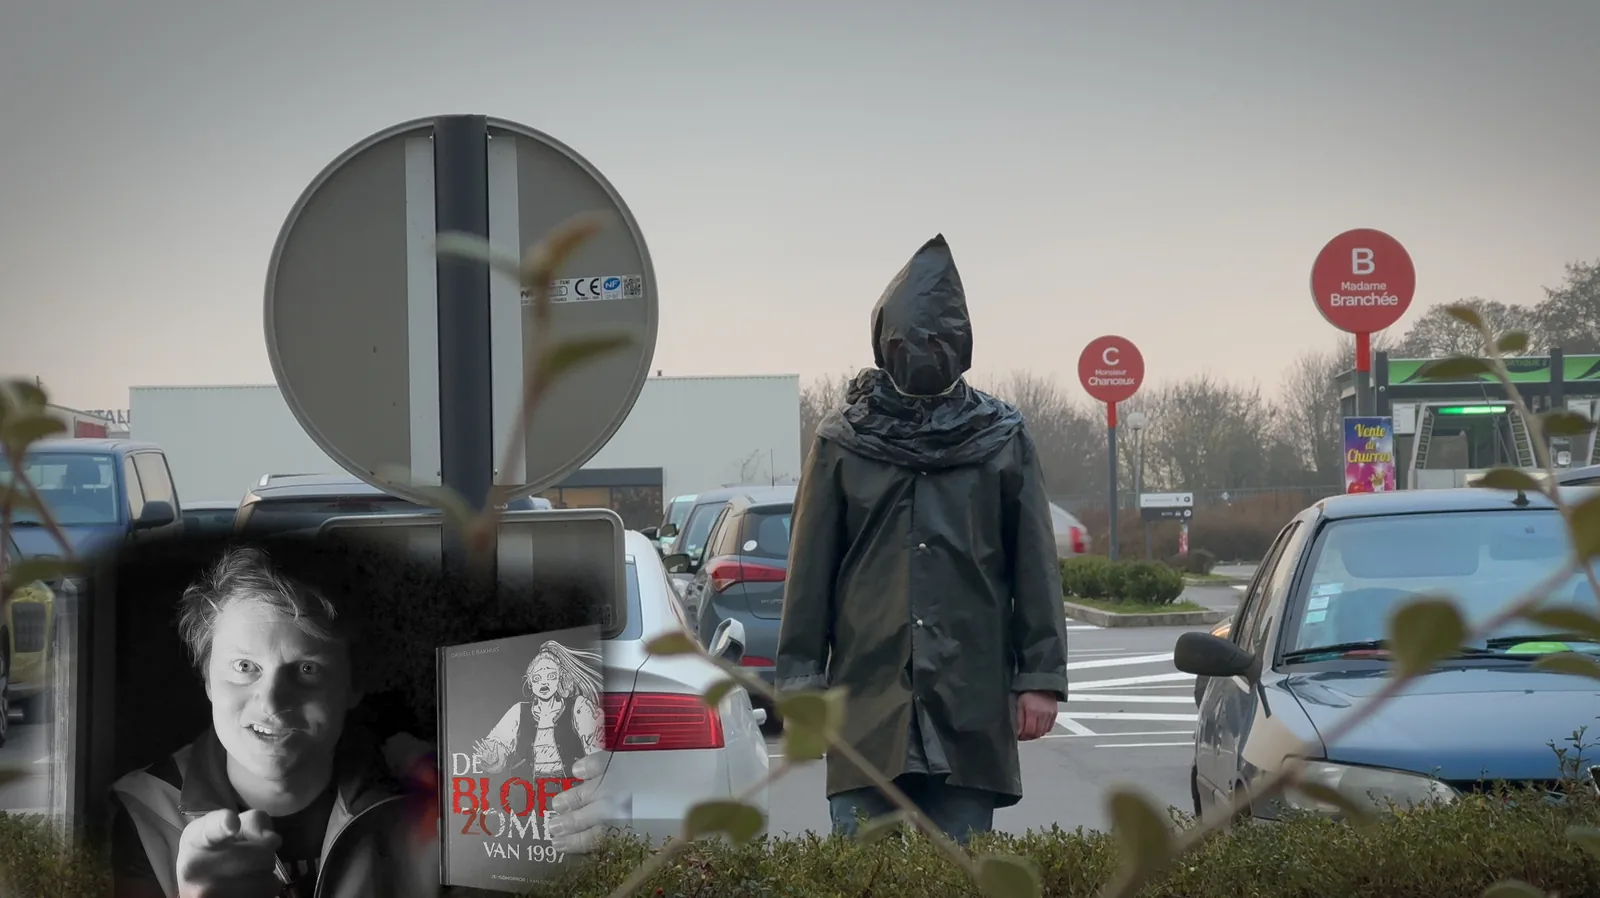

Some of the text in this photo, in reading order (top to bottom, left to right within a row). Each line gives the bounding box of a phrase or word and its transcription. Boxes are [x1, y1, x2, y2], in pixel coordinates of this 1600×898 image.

[1351, 247, 1376, 275] B
[575, 278, 600, 296] CE
[605, 279, 619, 289] NF
[1341, 281, 1387, 291] Madame
[1330, 292, 1398, 306] Branchée
[1102, 347, 1120, 366] C
[1088, 377, 1135, 386] Chanceux
[1354, 423, 1386, 438] Vente
[1347, 448, 1392, 463] Churros
[452, 752, 484, 776] DE
[452, 777, 585, 817] BLOE
[483, 841, 520, 860] VAN
